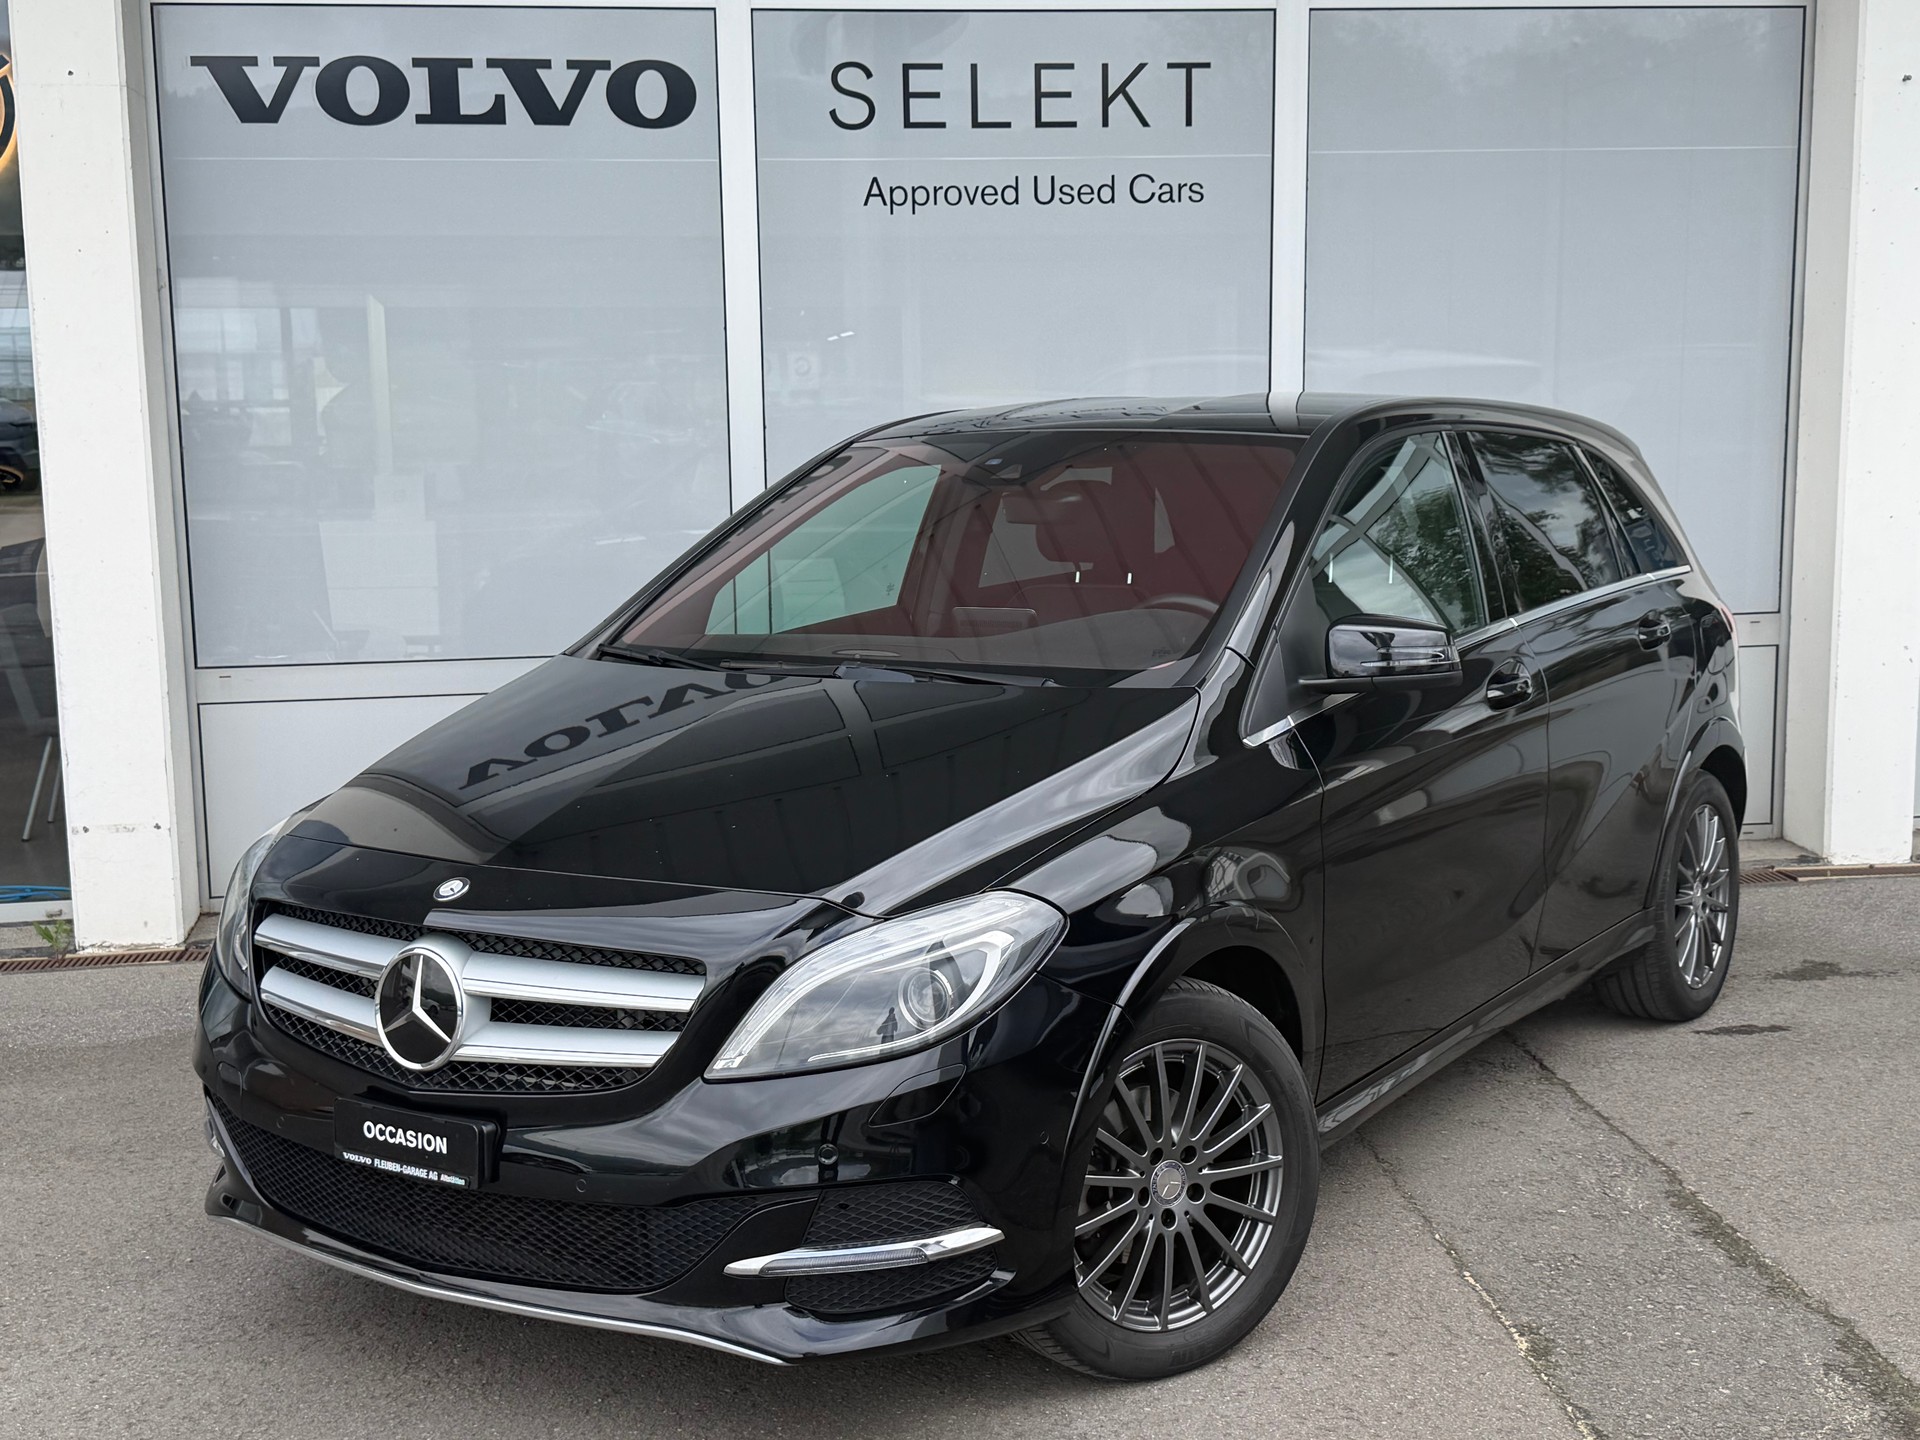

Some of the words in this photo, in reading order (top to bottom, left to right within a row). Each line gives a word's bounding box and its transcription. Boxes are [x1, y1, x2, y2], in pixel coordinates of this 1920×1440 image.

[190, 55, 697, 130] VOLVO
[829, 61, 1212, 131] SELEKT
[863, 175, 1020, 216] Approved
[1033, 174, 1116, 206] Used
[1130, 173, 1205, 205] Cars
[363, 1120, 448, 1154] OCCASION
[342, 1151, 372, 1165] VOLVO
[374, 1158, 428, 1179] FLEUBEN-GARAGE
[428, 1170, 439, 1181] AG
